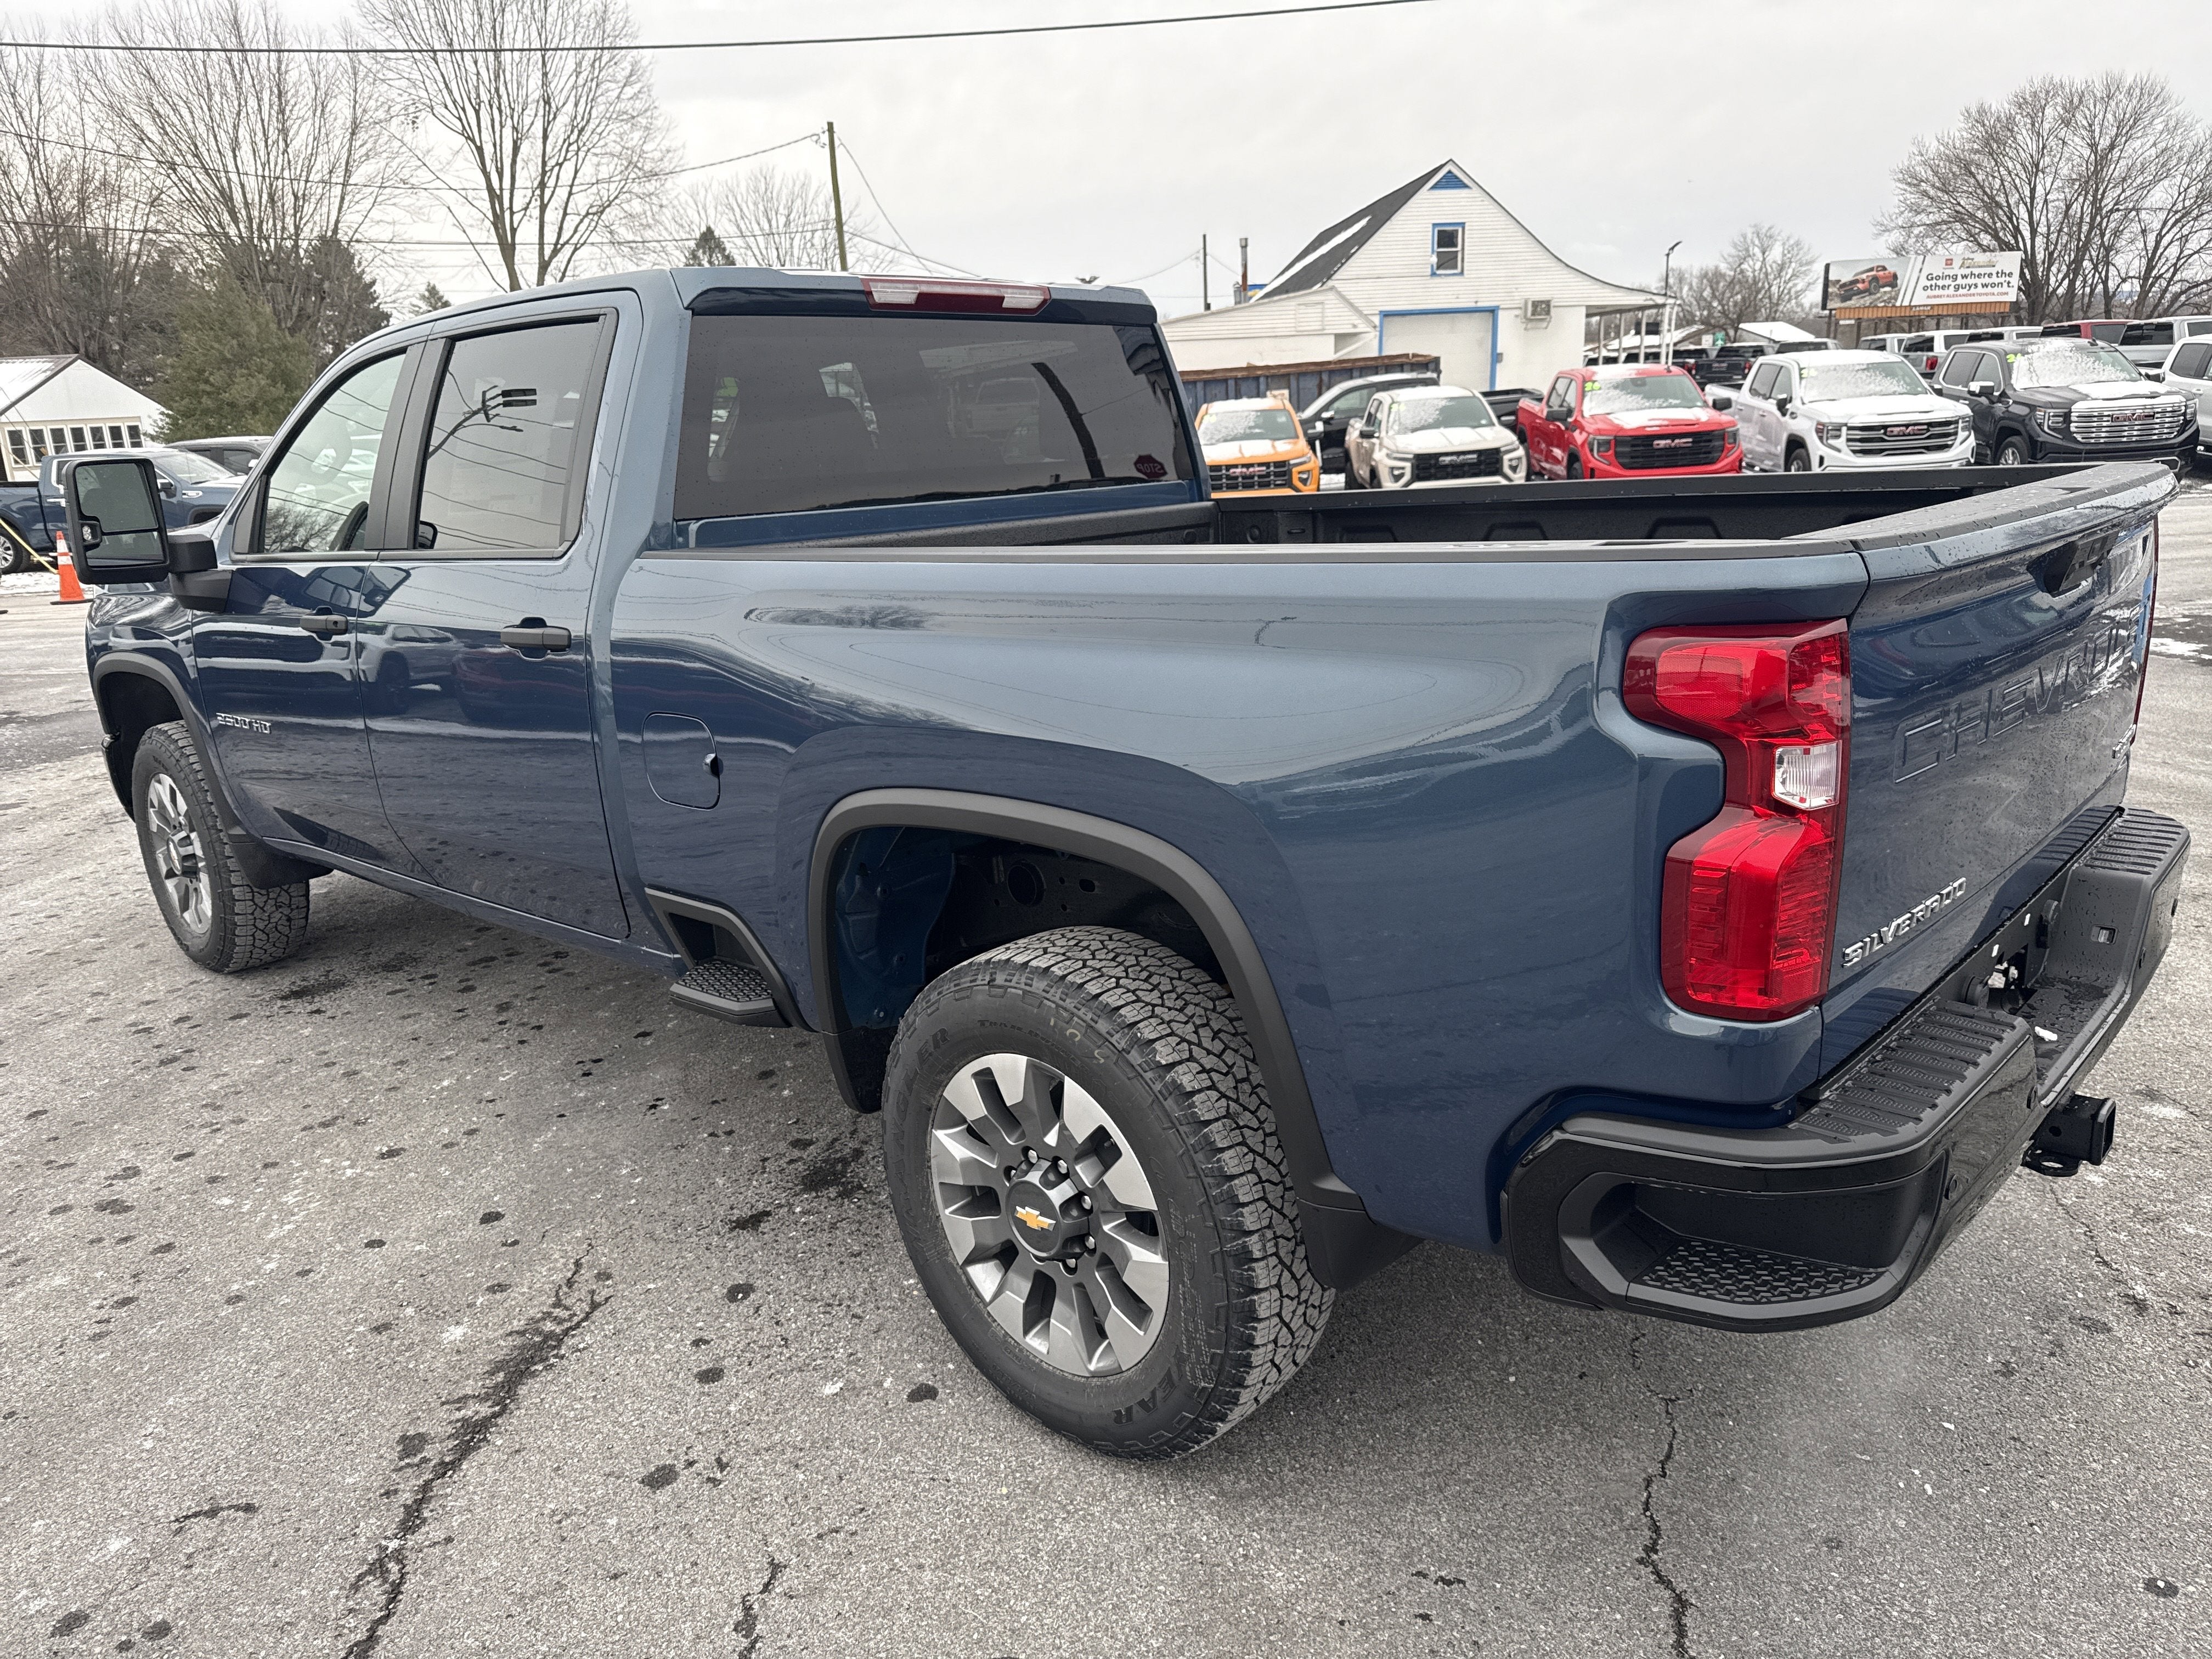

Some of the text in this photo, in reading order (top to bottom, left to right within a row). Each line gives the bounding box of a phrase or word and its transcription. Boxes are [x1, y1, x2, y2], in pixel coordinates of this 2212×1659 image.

[1926, 269, 2013, 283] Going where the
[1922, 280, 2015, 292] other guys won't.
[2113, 412, 2154, 422] GMC
[1886, 425, 1928, 436] GMC
[1652, 438, 1694, 448] GMC
[1438, 454, 1478, 465] GMC
[1229, 466, 1266, 477] GMC
[216, 713, 271, 734] 2500 HD
[1842, 877, 1966, 968] SILVERADO
[891, 1025, 951, 1268] WRANGLER
